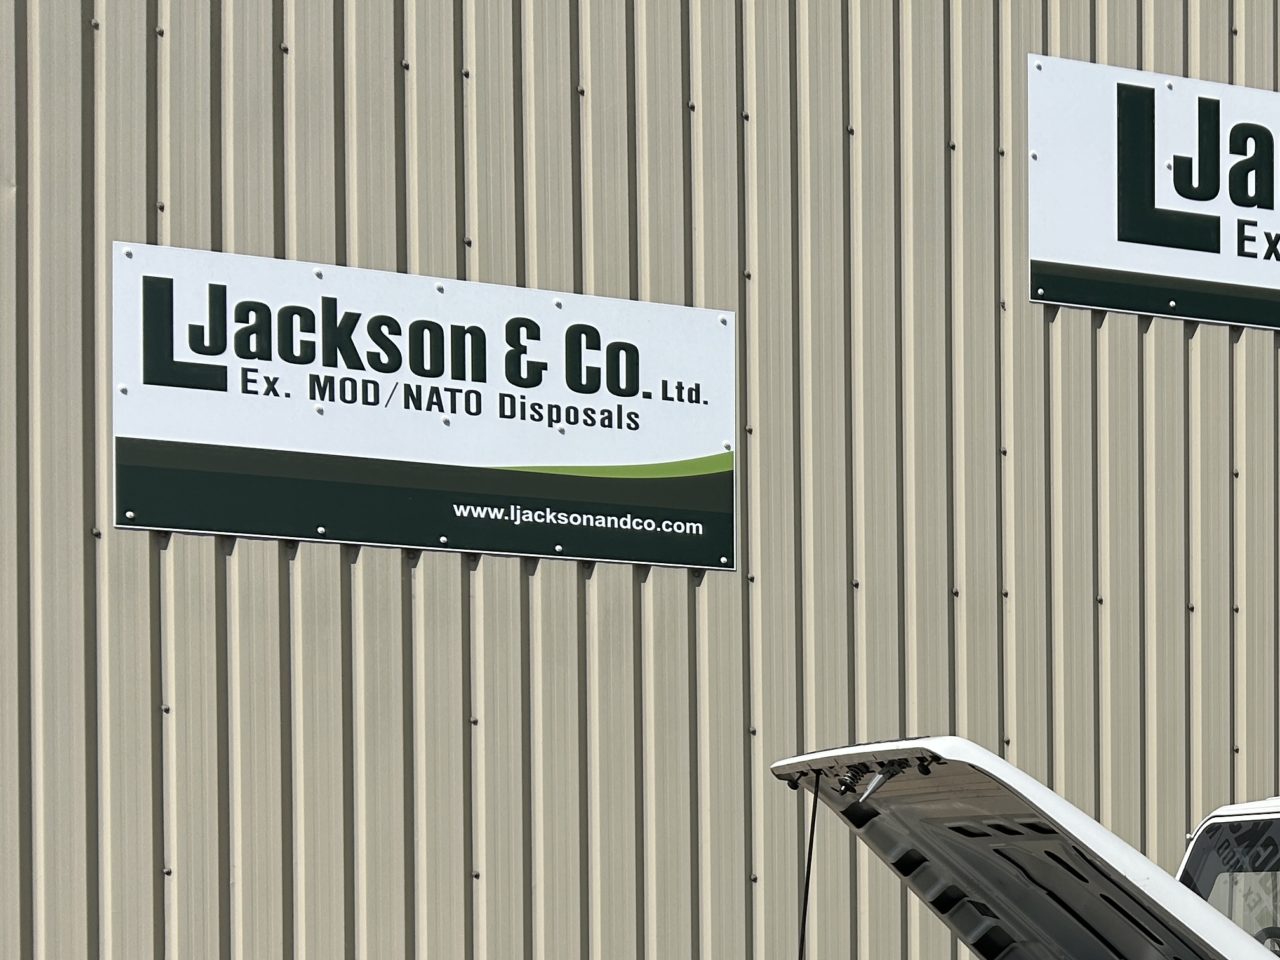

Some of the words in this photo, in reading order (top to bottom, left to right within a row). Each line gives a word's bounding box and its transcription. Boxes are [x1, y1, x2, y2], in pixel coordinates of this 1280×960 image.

[505, 318, 548, 389] &
[566, 324, 653, 400] Co.
[662, 380, 709, 405] Ltd.
[242, 368, 291, 398] Ex.
[310, 374, 482, 417] MOD/NATO
[499, 393, 640, 431] Disposals
[453, 503, 703, 536] www.ljacksonandco.com
